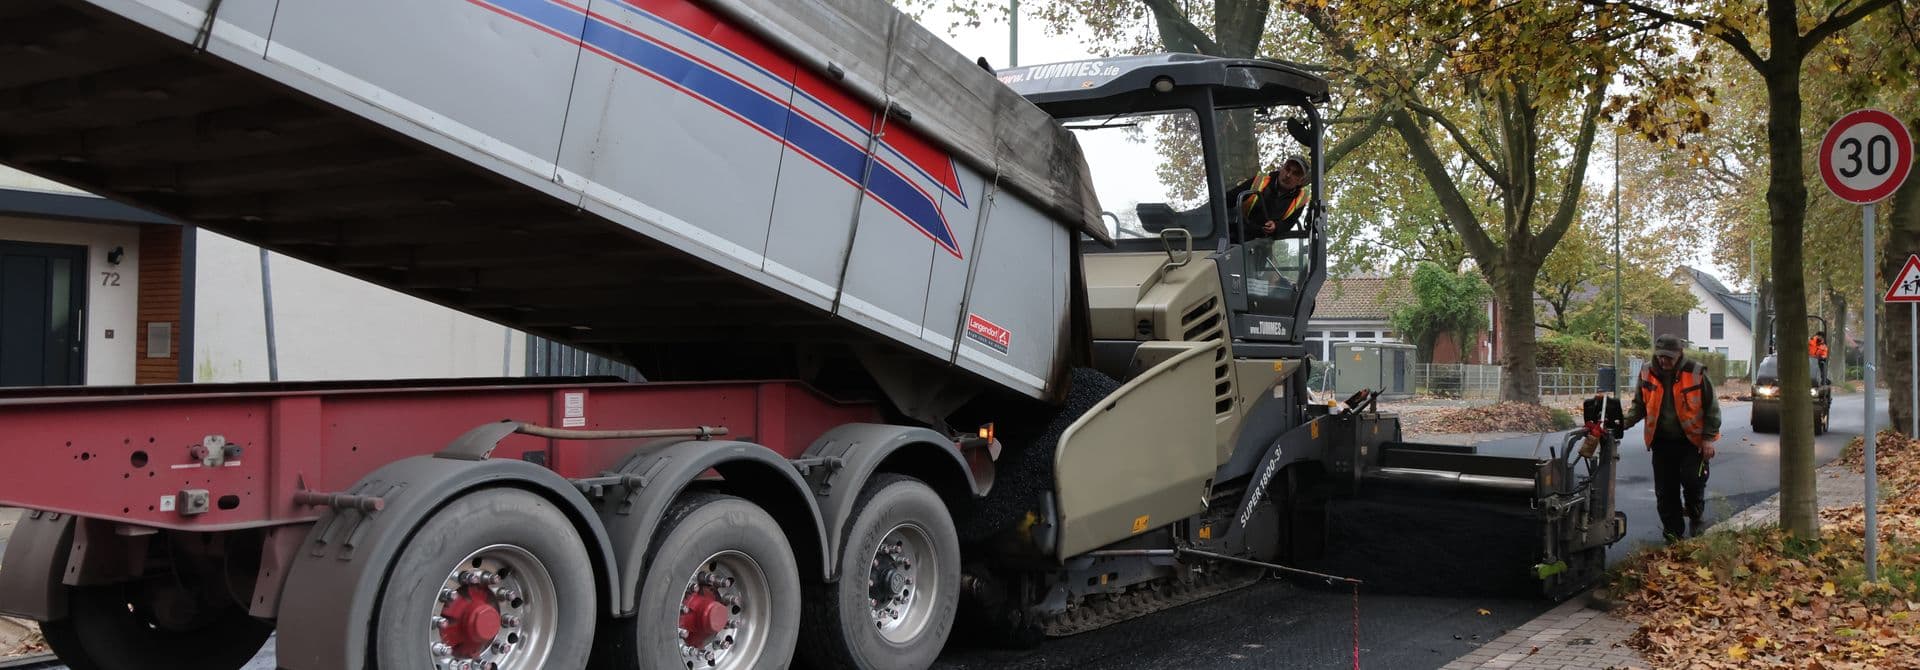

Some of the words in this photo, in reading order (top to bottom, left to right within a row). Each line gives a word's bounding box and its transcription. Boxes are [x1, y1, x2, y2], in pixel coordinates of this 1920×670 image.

[1839, 135, 1891, 178] 30
[101, 272, 121, 287] 72
[1240, 486, 1262, 528] SUPER
[1259, 444, 1282, 489] 1800-3i
